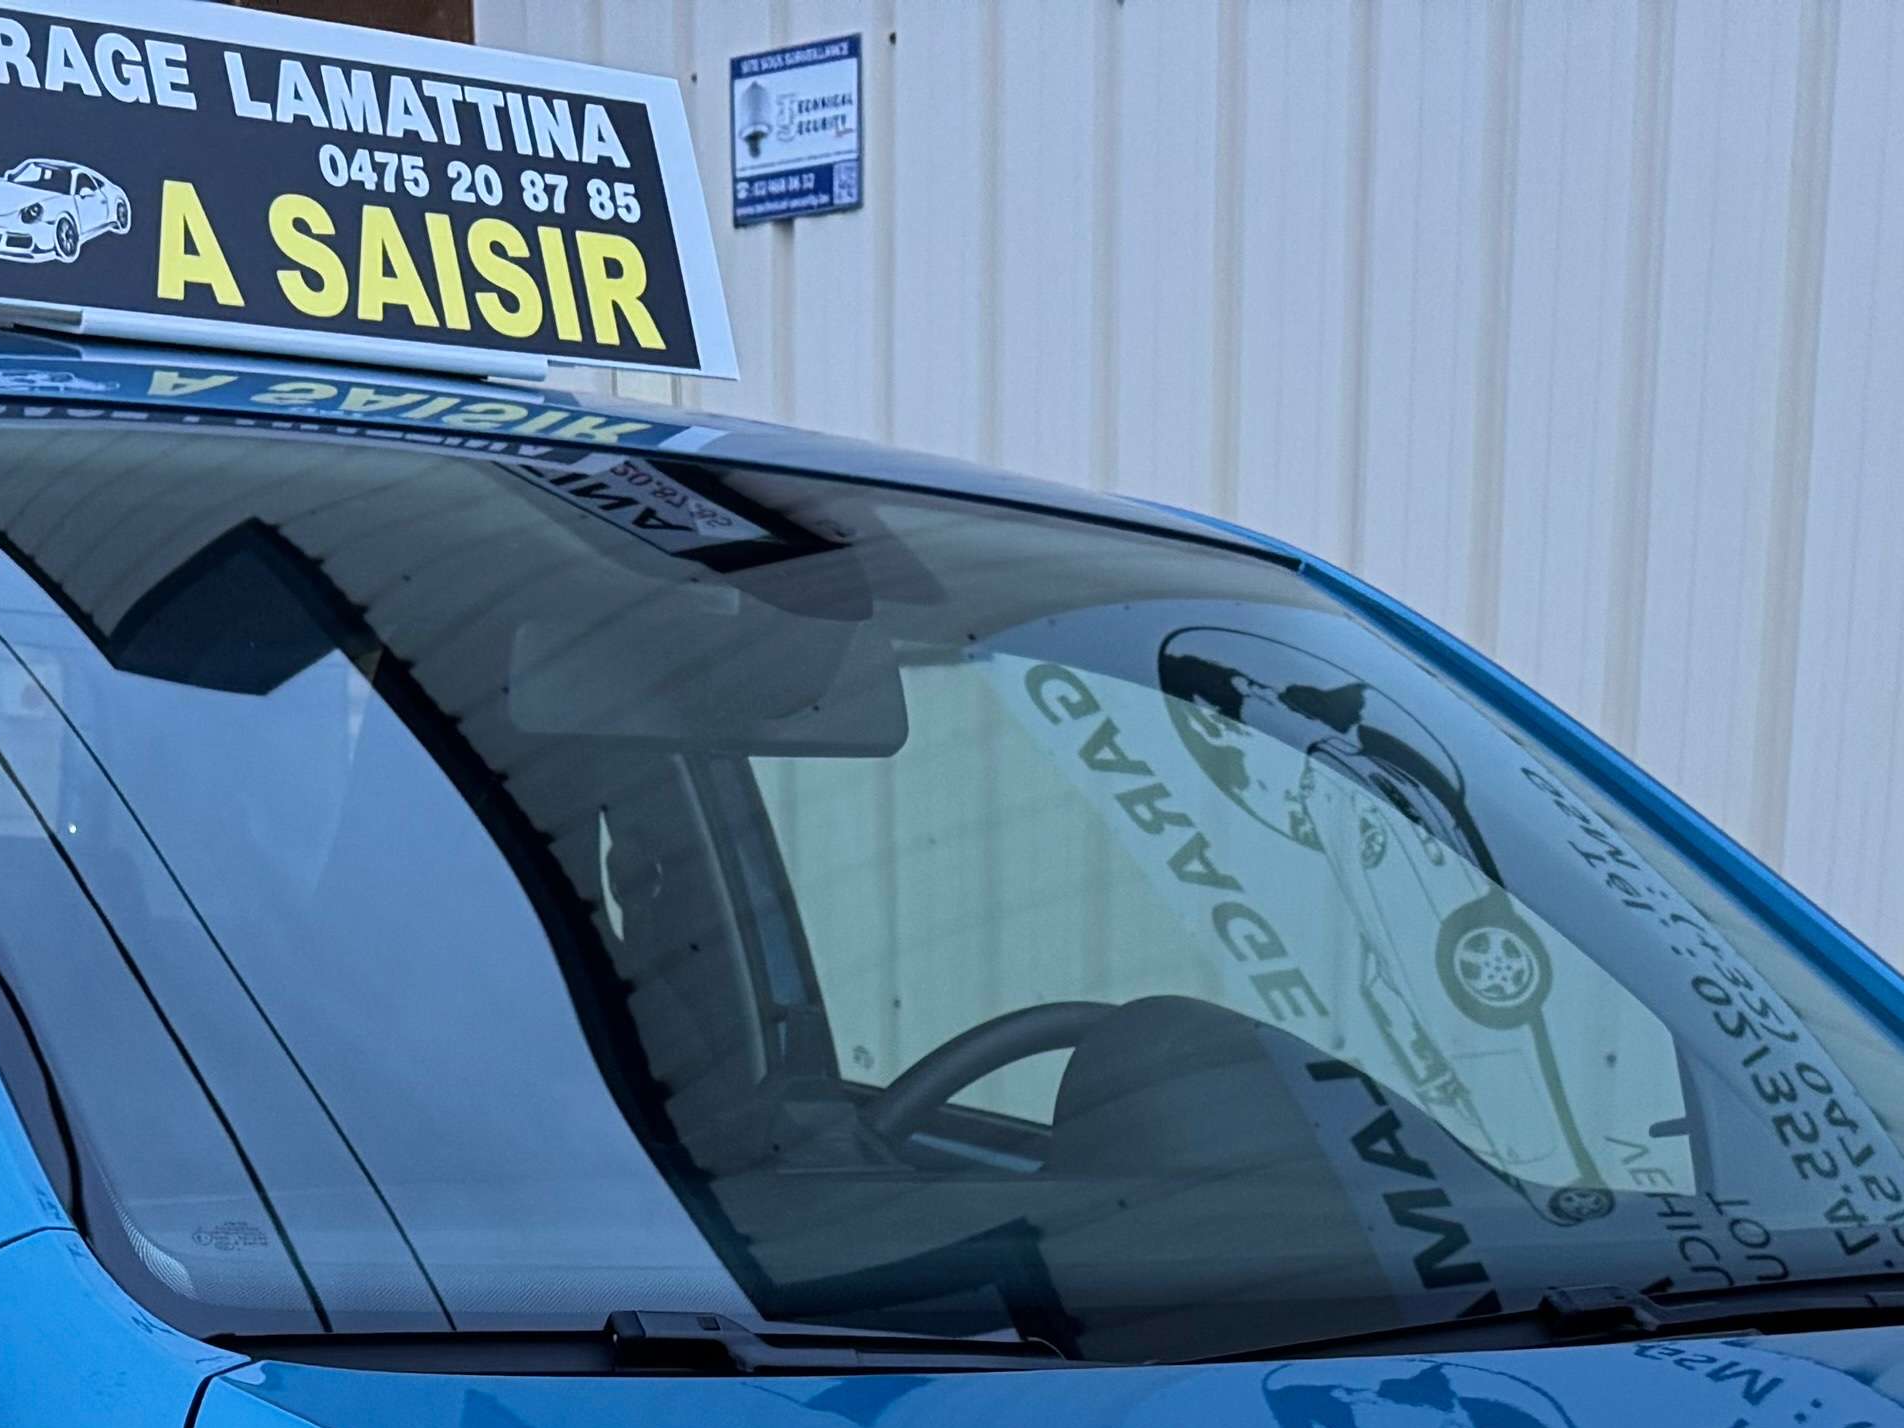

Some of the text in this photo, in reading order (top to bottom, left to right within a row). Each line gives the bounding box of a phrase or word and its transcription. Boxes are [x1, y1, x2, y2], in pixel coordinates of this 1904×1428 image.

[223, 51, 631, 169] LAMATTINA
[320, 144, 641, 224] 0475 20 87 85
[157, 179, 667, 350] A SAISIR
